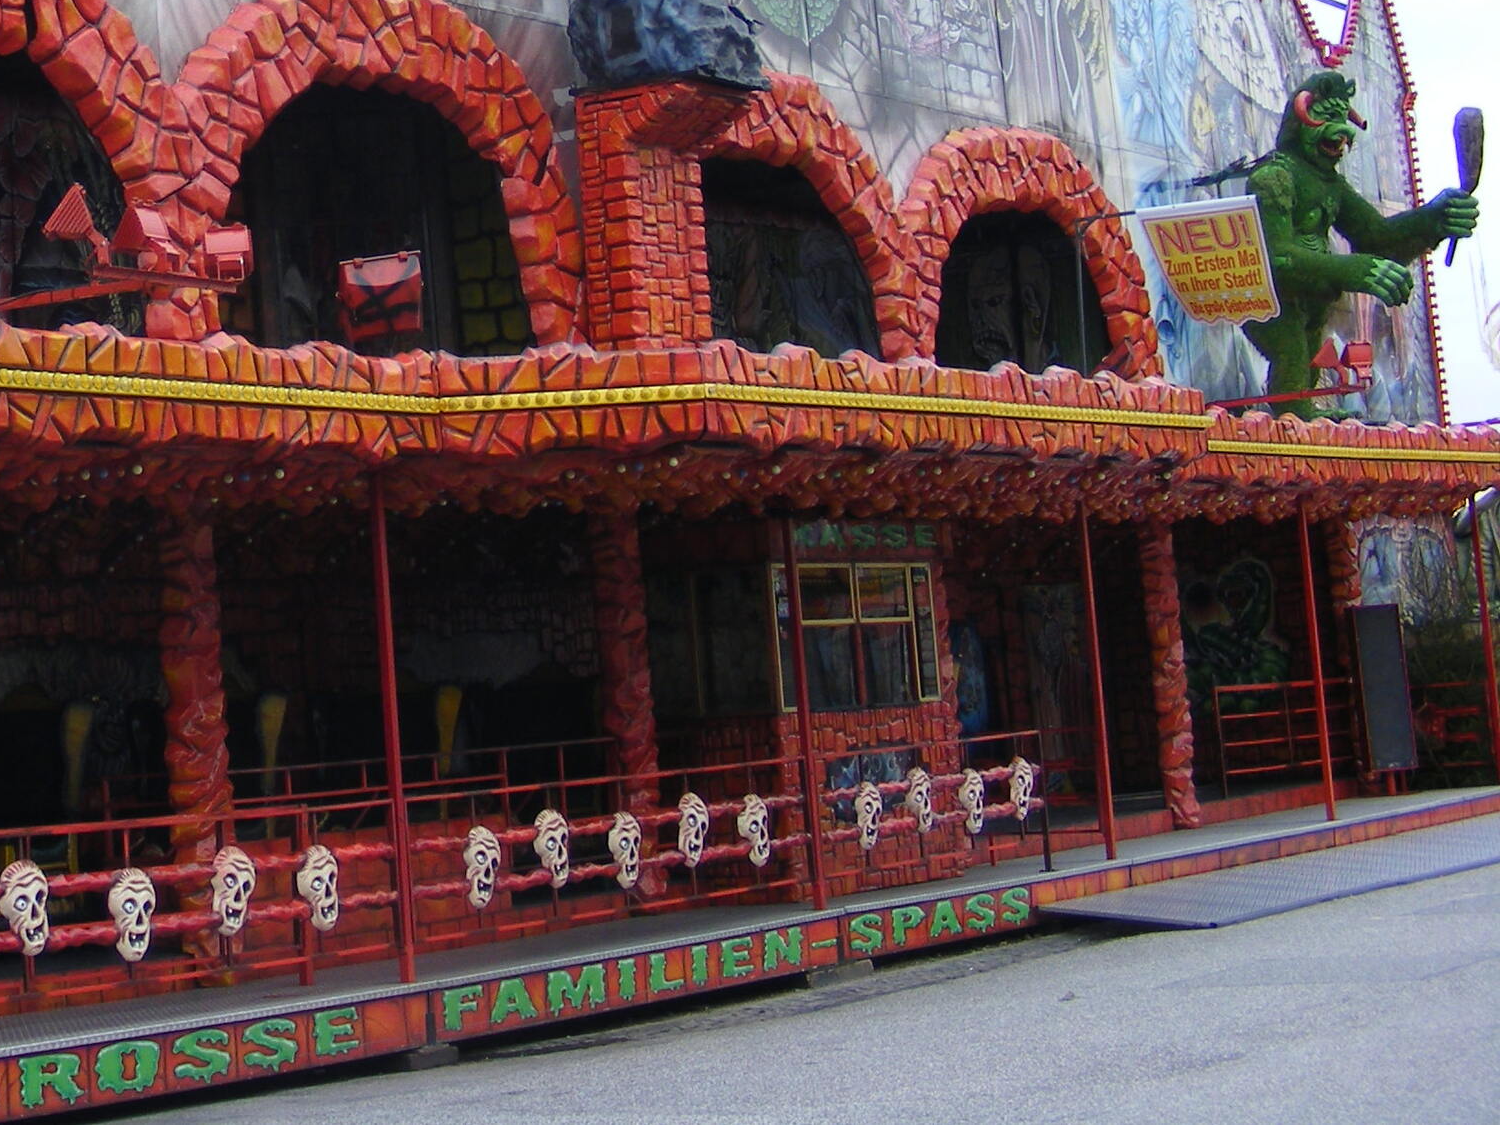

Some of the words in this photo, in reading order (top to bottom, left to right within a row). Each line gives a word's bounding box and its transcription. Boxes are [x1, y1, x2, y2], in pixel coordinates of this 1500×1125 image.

[1154, 213, 1254, 258] NEU!
[1163, 258, 1194, 277] Zum
[1194, 253, 1236, 274] Ersten
[1237, 247, 1262, 268] Mal
[1175, 279, 1190, 293] in
[1190, 275, 1221, 293] Ihrer
[1223, 268, 1264, 290] Stadt!
